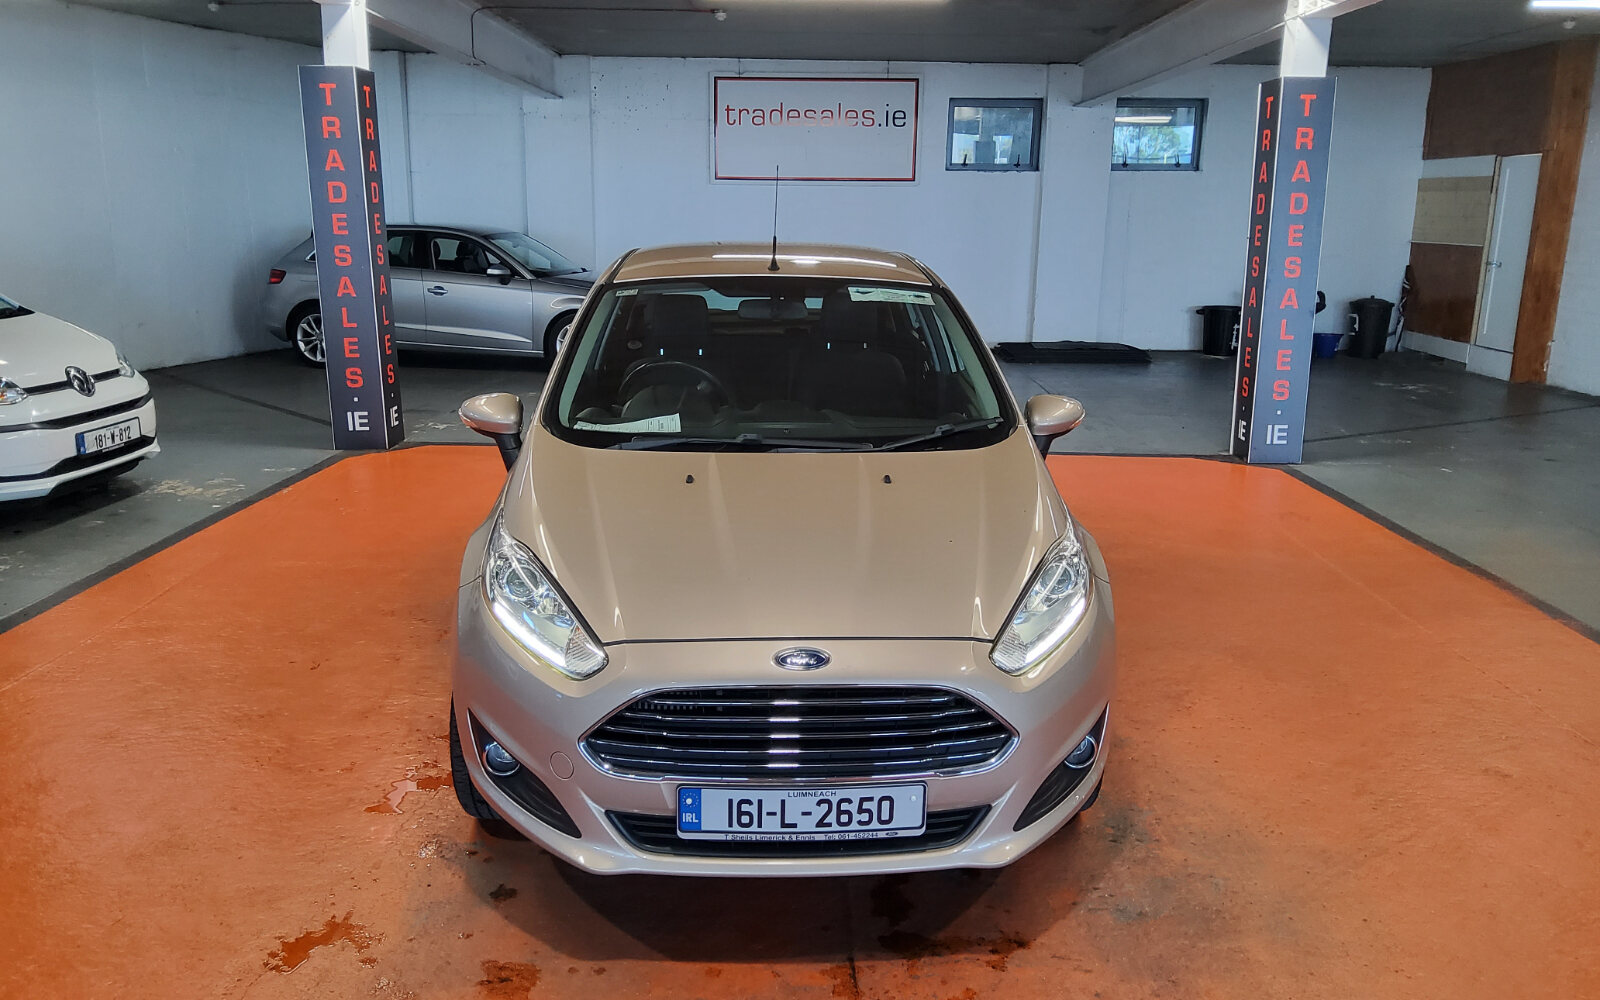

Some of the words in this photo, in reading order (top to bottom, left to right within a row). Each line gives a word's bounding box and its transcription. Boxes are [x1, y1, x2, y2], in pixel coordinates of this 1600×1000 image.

[724, 102, 907, 128] tradesales.ie
[94, 425, 132, 450] 181-W-812
[787, 790, 837, 798] LUIMNEACH
[682, 812, 699, 823] IRL
[727, 795, 895, 829] 161-L-2650
[837, 832, 879, 840] 061-452244
